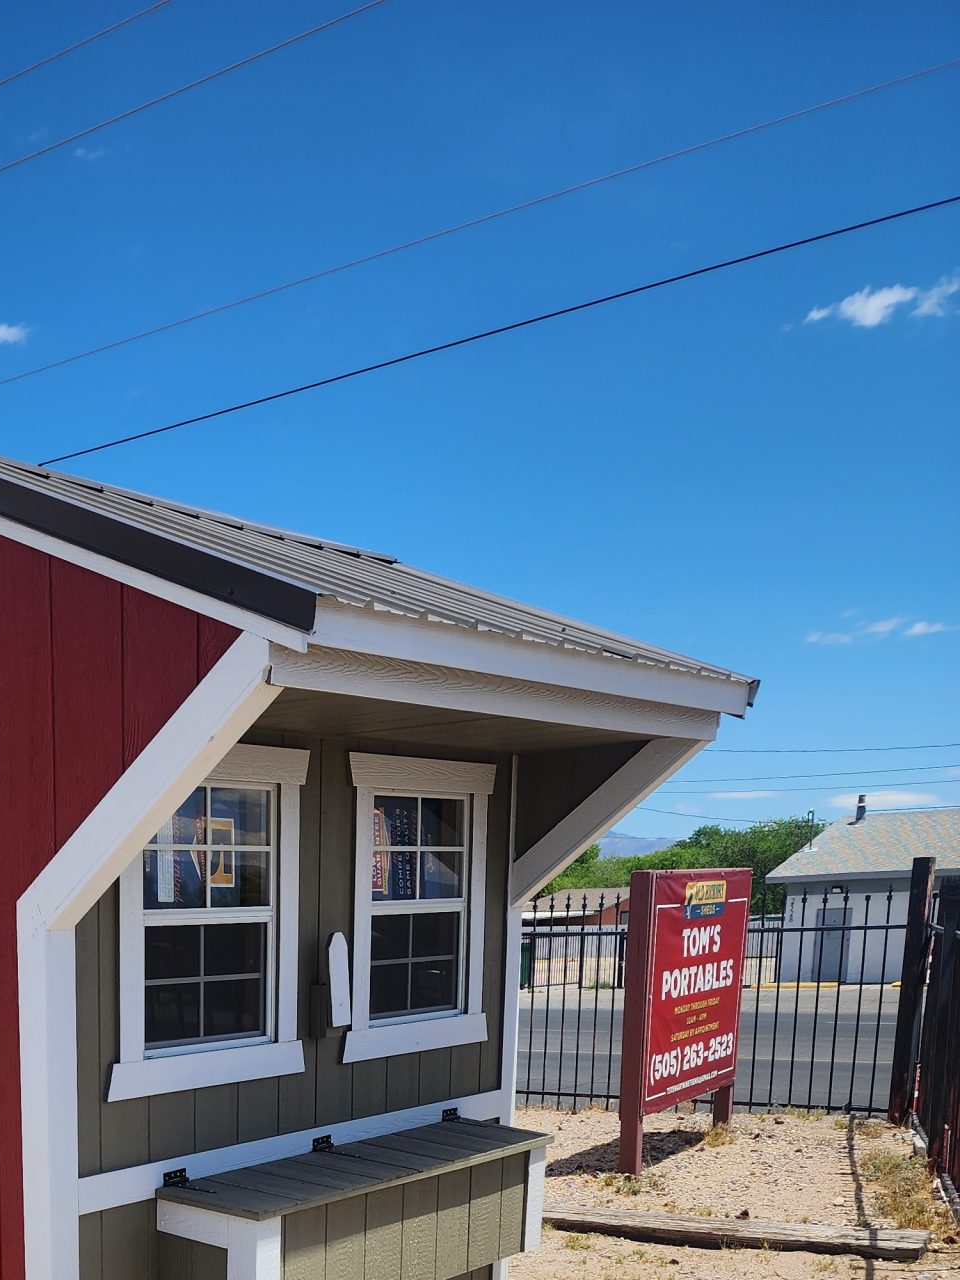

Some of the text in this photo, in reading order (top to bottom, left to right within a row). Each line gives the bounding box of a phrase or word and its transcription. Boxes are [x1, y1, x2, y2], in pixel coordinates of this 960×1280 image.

[396, 808, 404, 895] COMPEITOR'S
[682, 924, 721, 958] TOM'S
[661, 958, 734, 1001] PORTABLES
[650, 1046, 681, 1087] (505)
[683, 1032, 734, 1071] 263-2523
